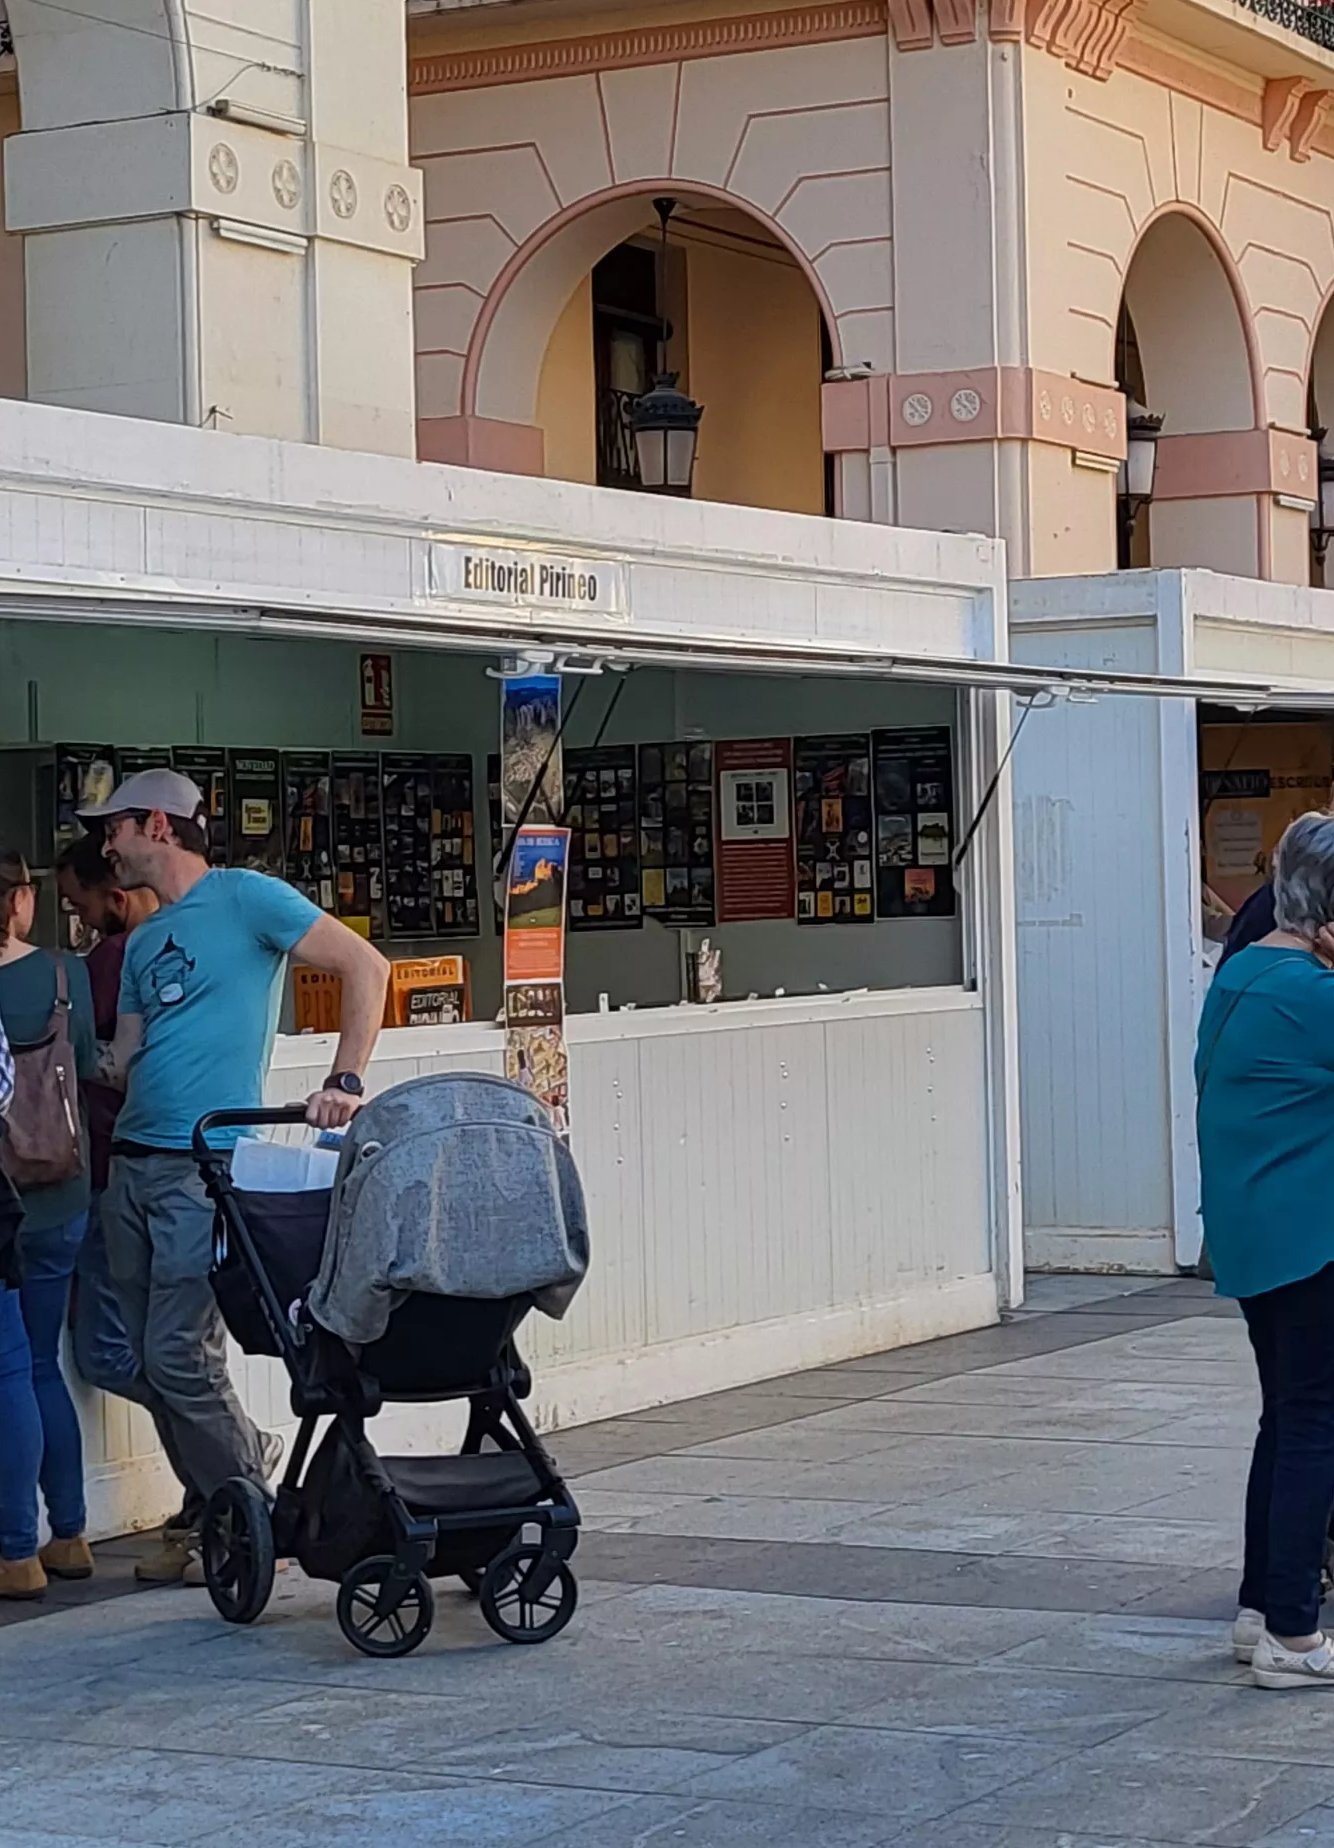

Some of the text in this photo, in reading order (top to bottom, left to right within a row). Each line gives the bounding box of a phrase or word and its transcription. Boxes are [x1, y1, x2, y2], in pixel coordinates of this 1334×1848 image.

[464, 556, 597, 601] Editorial Pirineo
[410, 991, 460, 1010] EDITORIAL
